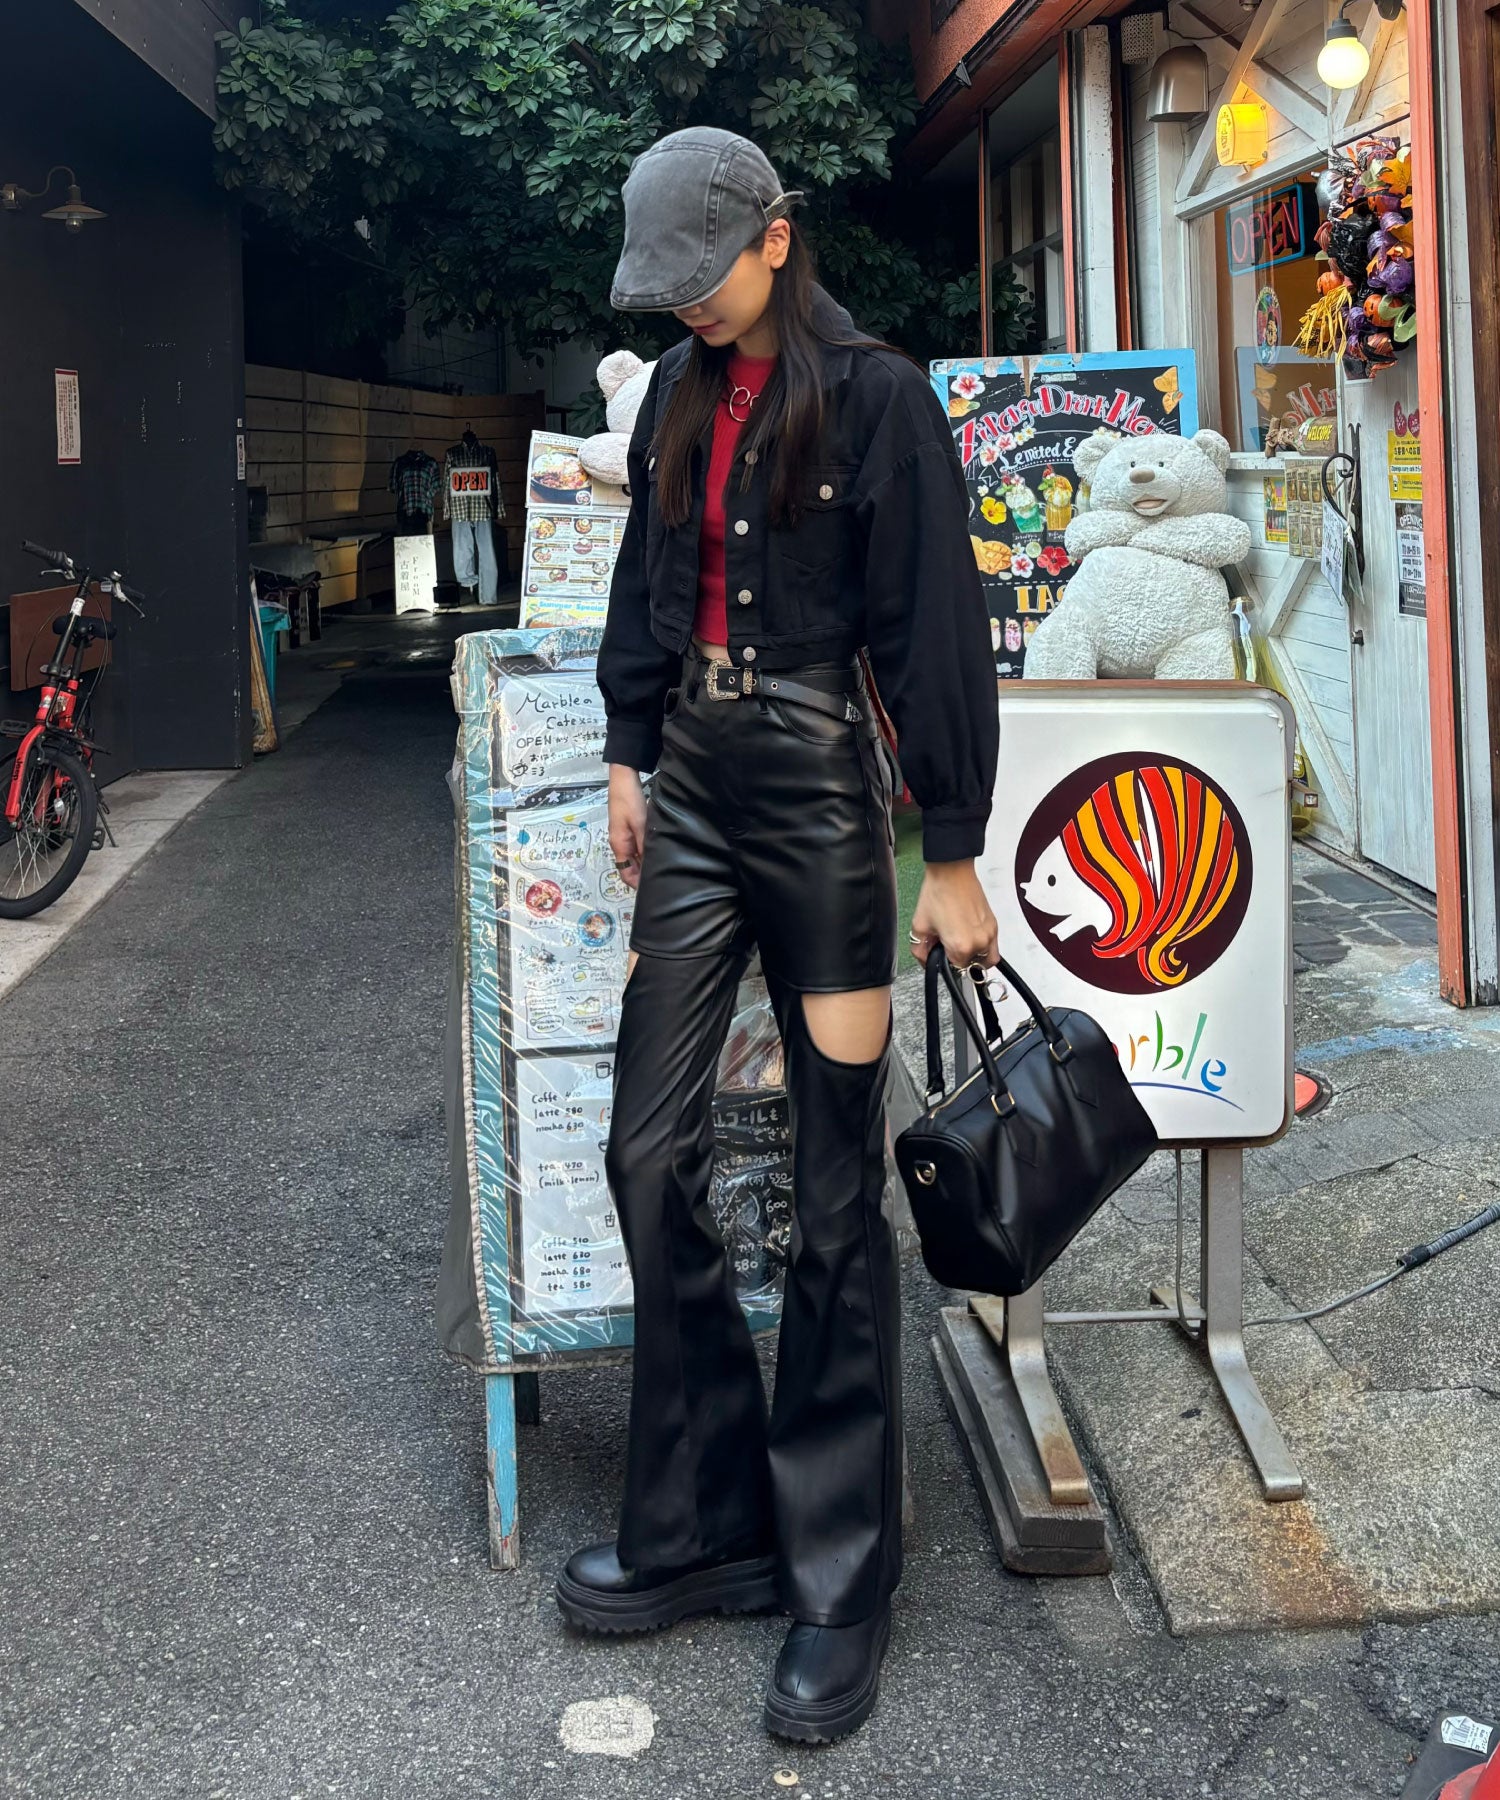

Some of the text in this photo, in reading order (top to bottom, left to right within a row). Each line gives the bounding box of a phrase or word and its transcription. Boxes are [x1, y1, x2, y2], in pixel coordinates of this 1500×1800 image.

[1231, 197, 1300, 263] OPEN
[452, 471, 489, 492] OPEN
[539, 600, 605, 612] Summer Special
[516, 735, 552, 749] OPEN
[535, 1109, 560, 1119] latte
[536, 1122, 564, 1132] mocha
[564, 1161, 583, 1169] 470
[769, 1172, 788, 1185] 550
[766, 1200, 788, 1213] 600
[573, 1237, 589, 1245] 510
[544, 1252, 567, 1262] latte
[540, 1266, 591, 1276] mocha 680
[609, 1260, 622, 1270] ice
[734, 1258, 759, 1272] 580
[547, 1280, 591, 1292] tea 580
